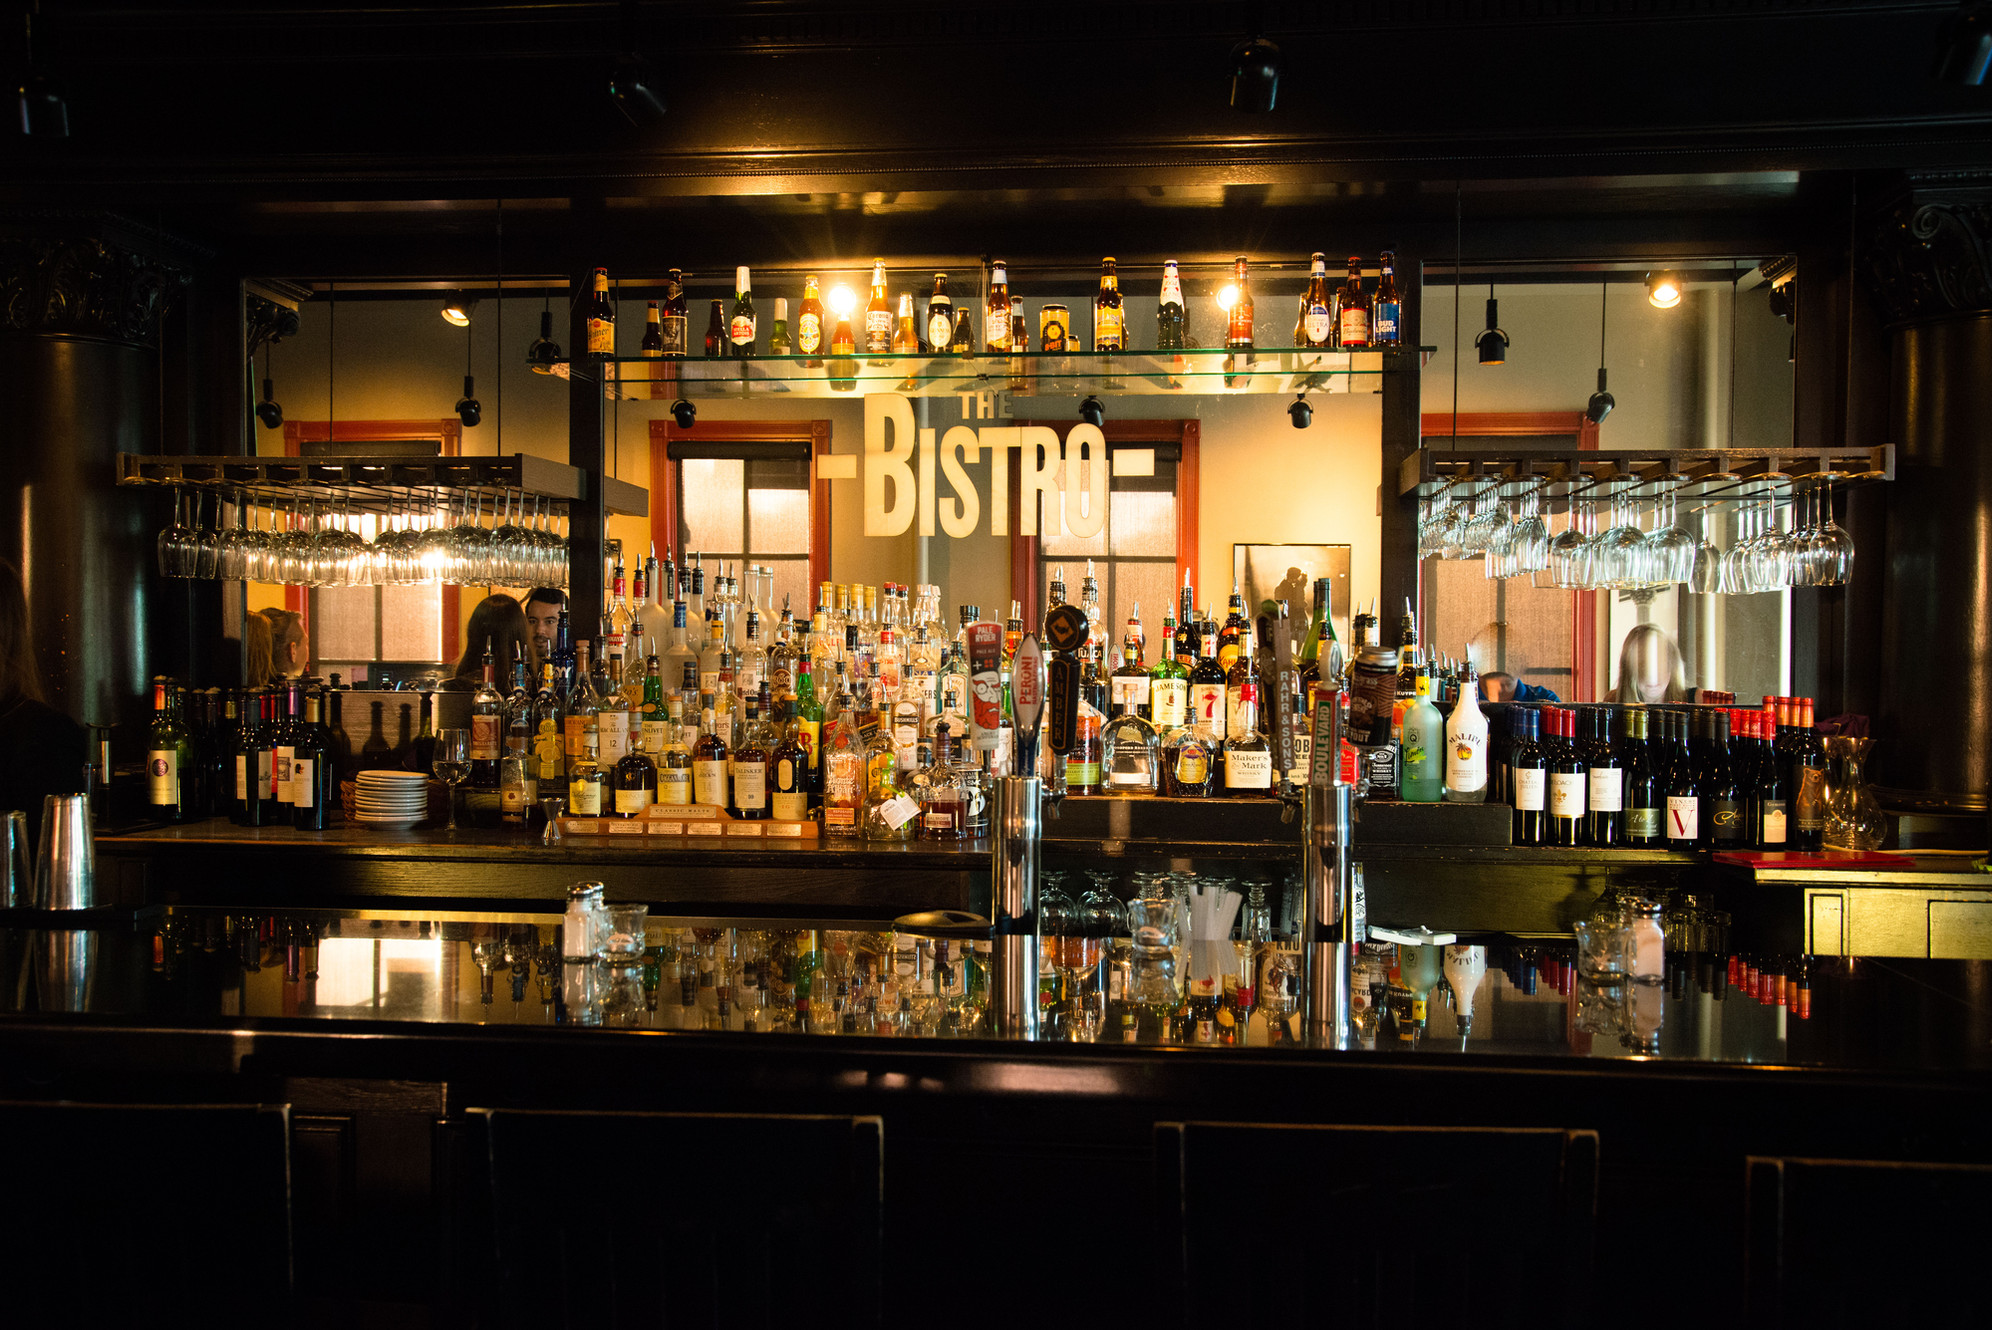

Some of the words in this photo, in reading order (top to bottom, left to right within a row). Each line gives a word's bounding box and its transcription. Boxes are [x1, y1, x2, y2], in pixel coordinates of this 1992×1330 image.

[956, 390, 1014, 419] THE
[863, 392, 1107, 539] BISTRO
[975, 634, 997, 643] RYDER
[977, 626, 993, 634] PALE
[1019, 655, 1033, 705] PERONI
[1155, 682, 1187, 692] JAMESON
[1280, 670, 1290, 712] RAHR
[1055, 666, 1063, 740] AMBER
[1281, 715, 1290, 725] &
[609, 739, 617, 748] 12
[1281, 727, 1293, 770] SONS
[1294, 738, 1310, 753] OB
[1314, 705, 1331, 784] BOULEVARD
[1409, 733, 1418, 743] Q
[1449, 733, 1482, 747] MALIBU
[1670, 809, 1695, 837] V
